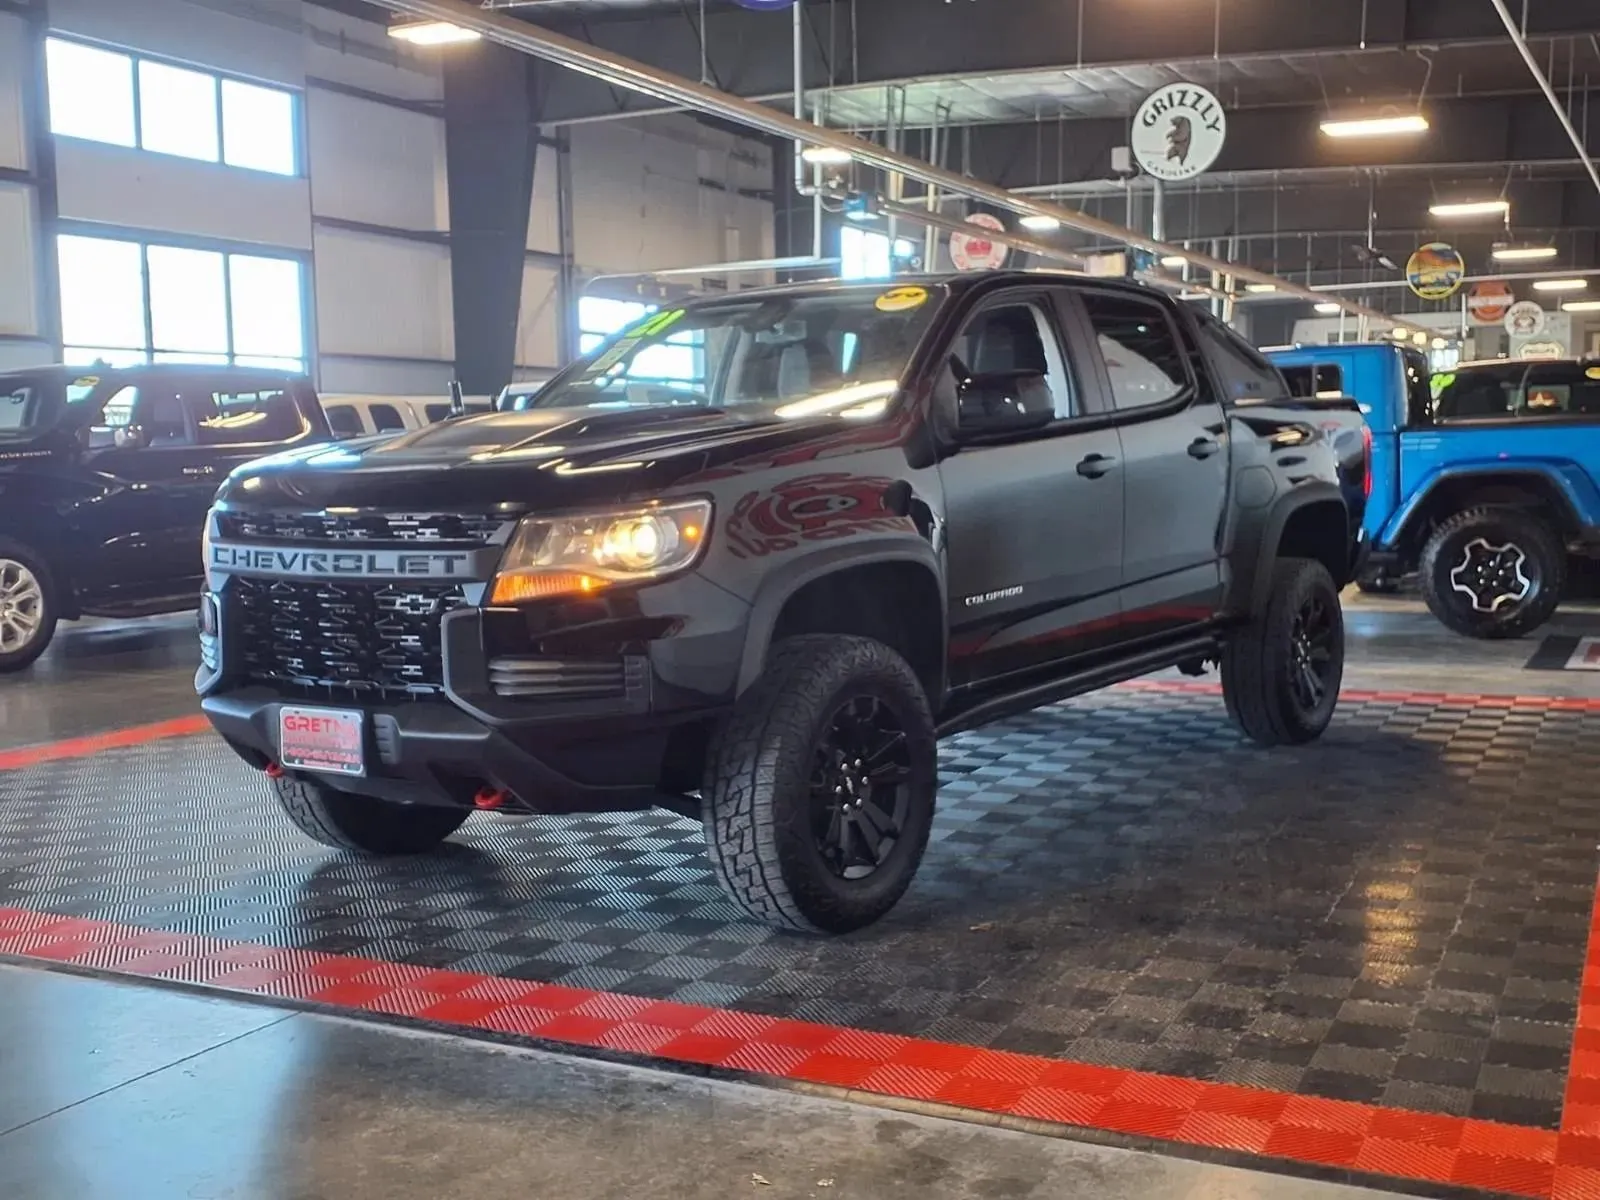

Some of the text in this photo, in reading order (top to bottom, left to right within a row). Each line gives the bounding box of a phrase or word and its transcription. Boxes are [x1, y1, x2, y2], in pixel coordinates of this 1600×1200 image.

[1142, 89, 1221, 132] GRIZZLY
[213, 546, 467, 575] CHEVROLET
[965, 585, 1024, 606] COLORADO
